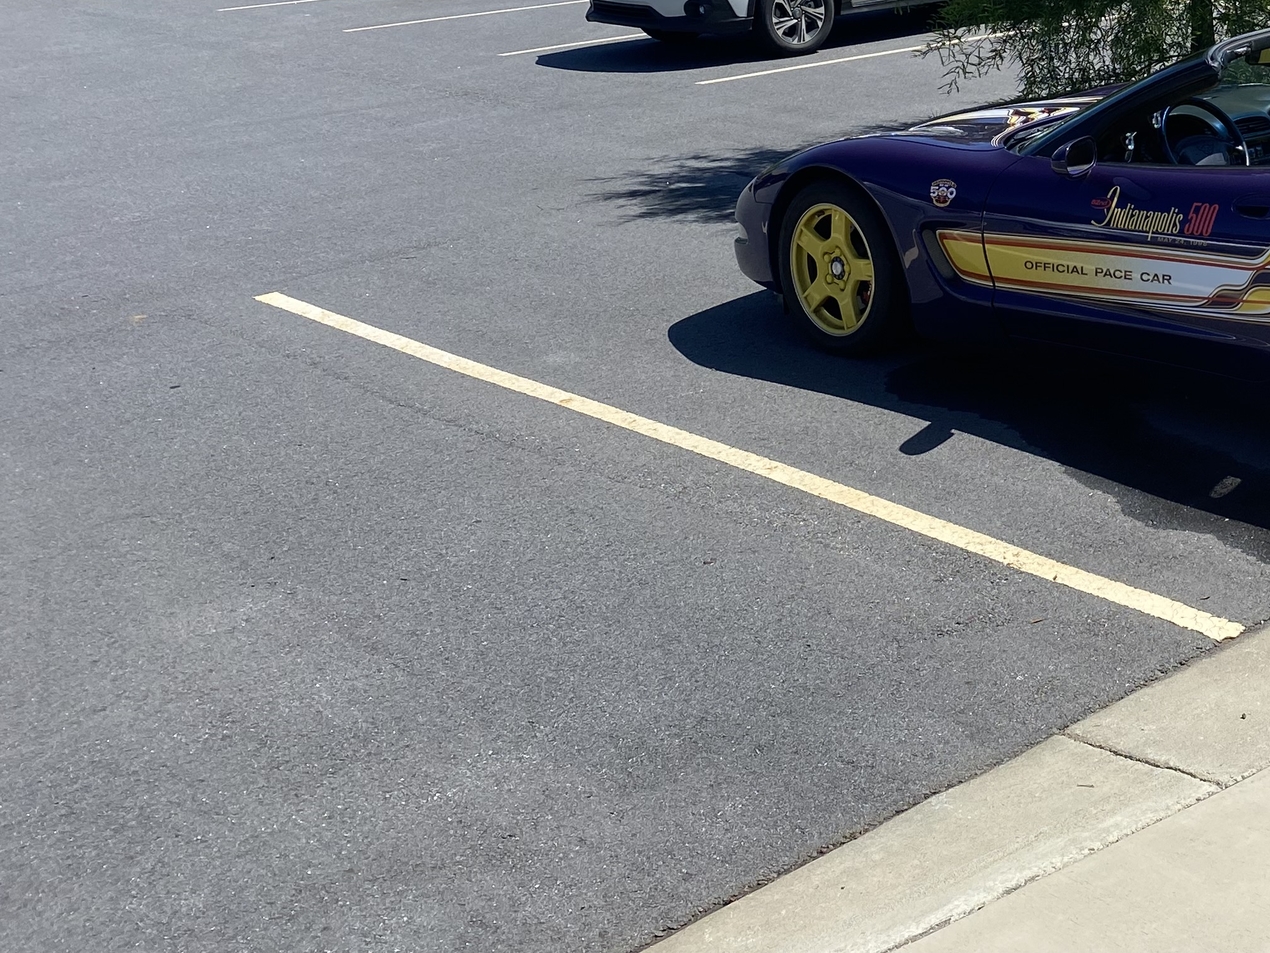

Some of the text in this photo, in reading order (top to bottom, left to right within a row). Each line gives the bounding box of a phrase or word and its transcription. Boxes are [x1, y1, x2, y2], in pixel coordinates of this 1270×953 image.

[930, 186, 956, 200] 500
[1091, 185, 1219, 241] Indianapolis 500
[1024, 260, 1172, 285] OFFICIAL PACE CAR
